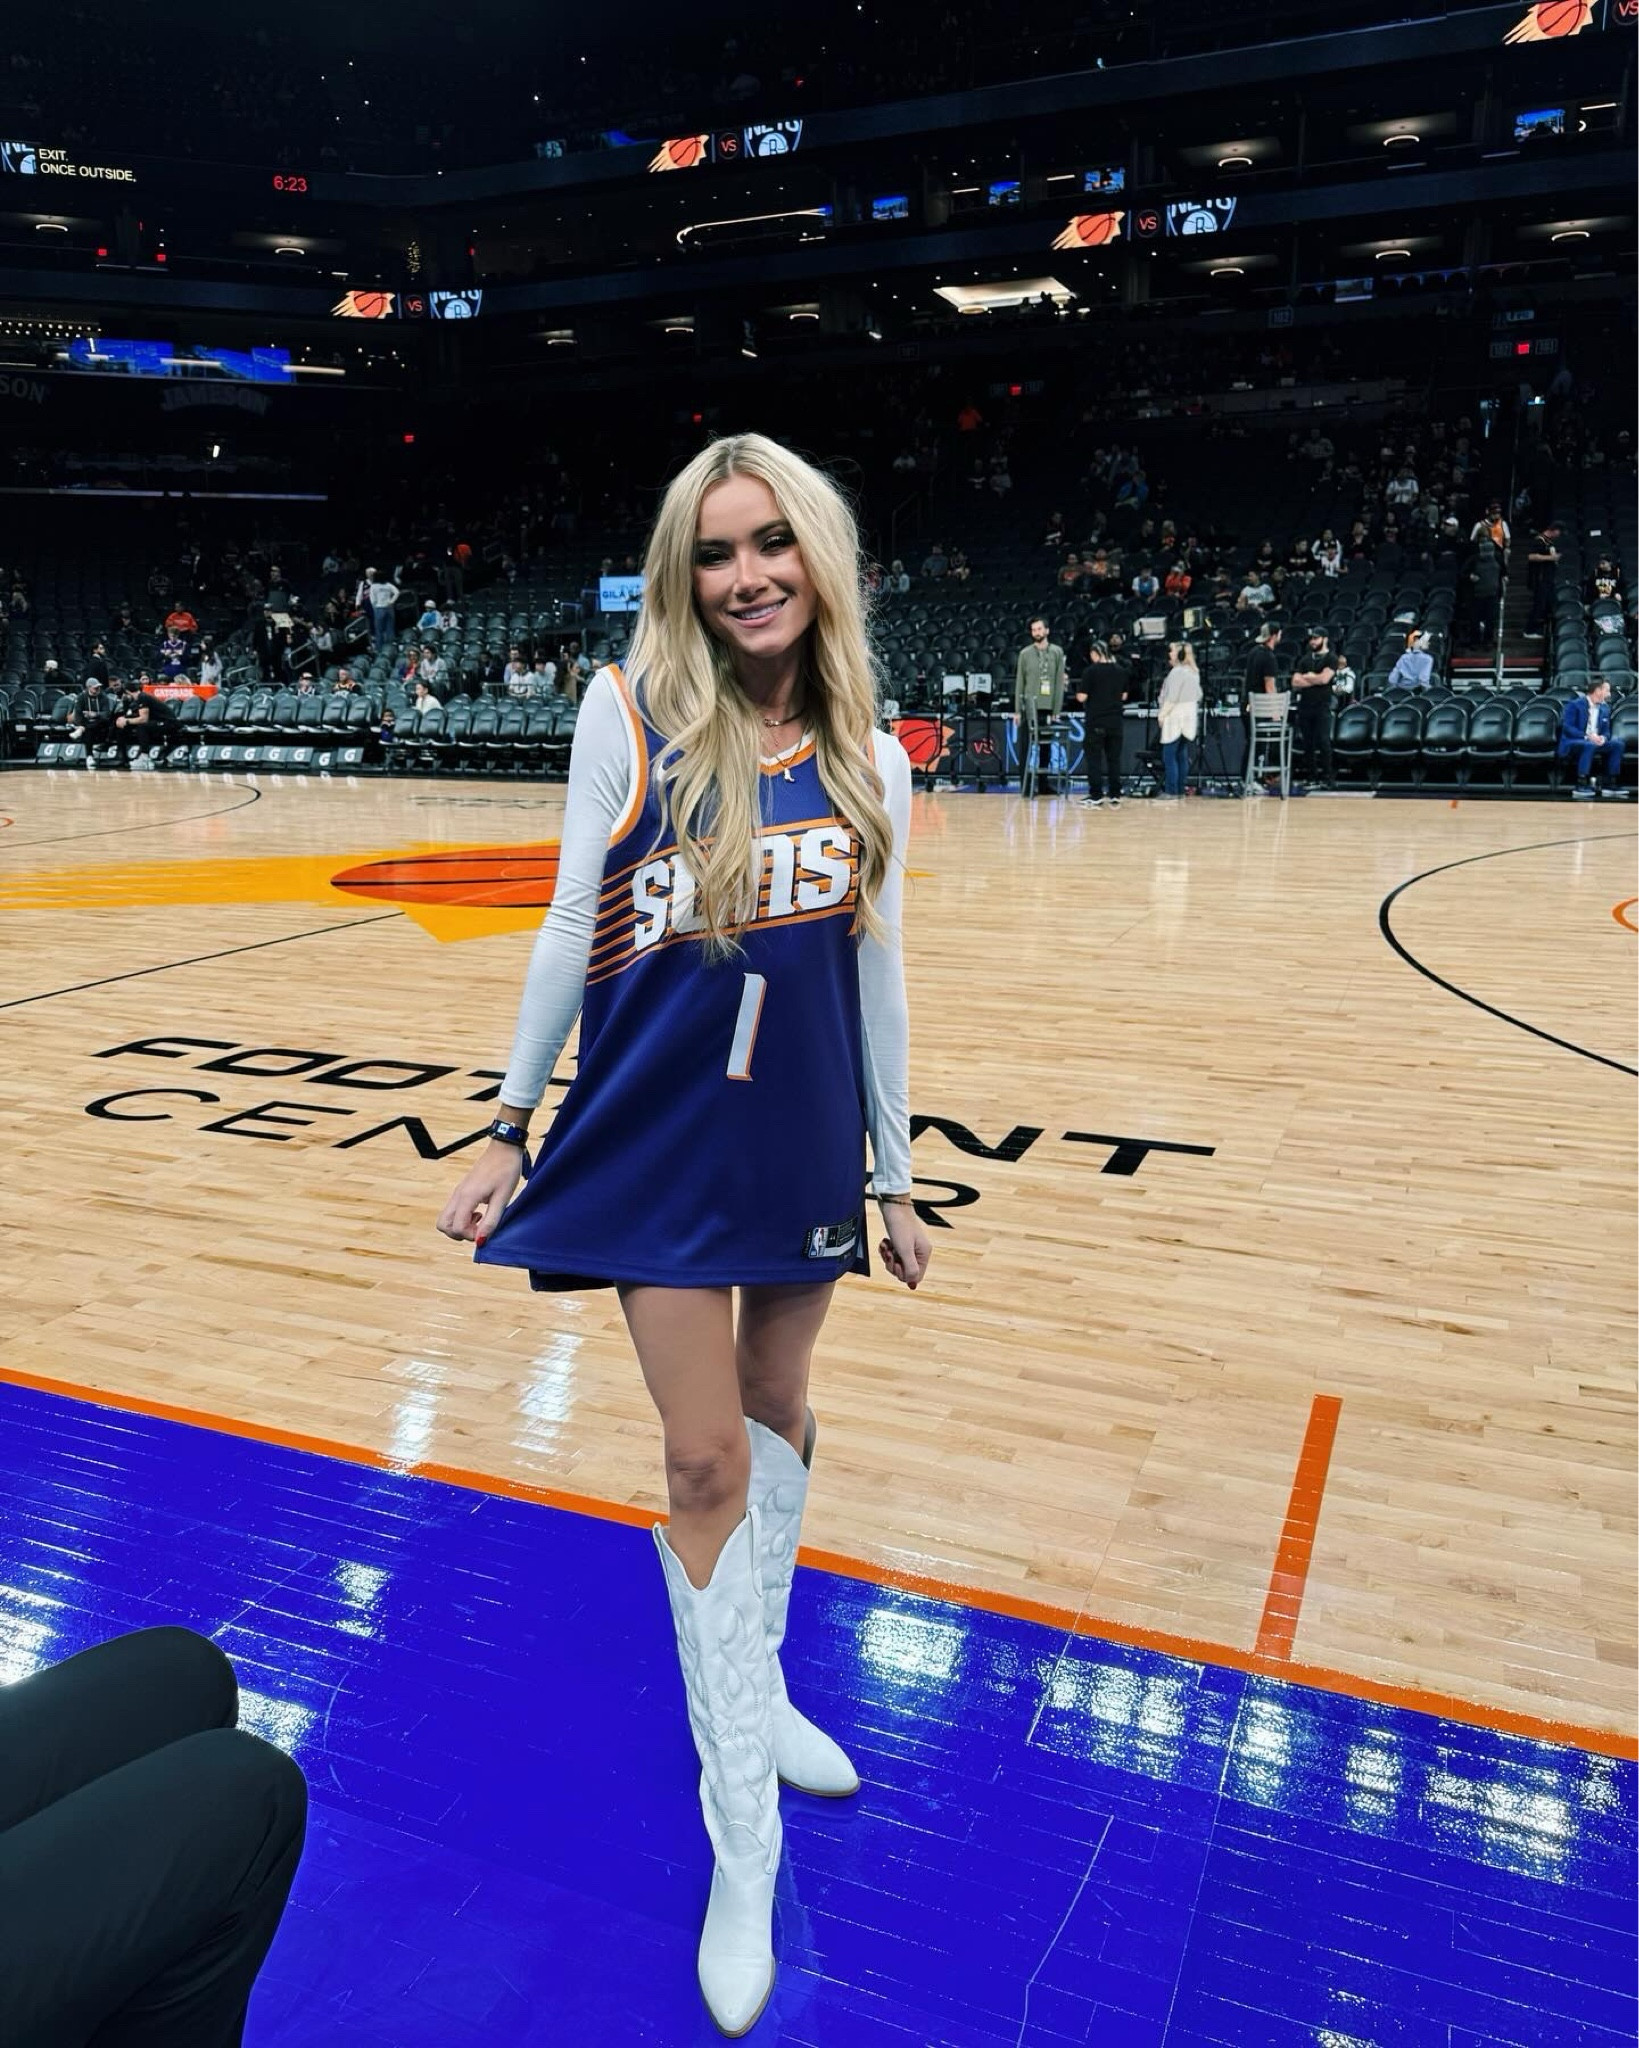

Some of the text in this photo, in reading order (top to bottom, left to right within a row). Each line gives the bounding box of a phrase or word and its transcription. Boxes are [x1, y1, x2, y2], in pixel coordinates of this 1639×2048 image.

[720, 139, 737, 153] VS
[38, 148, 69, 161] EXIT.
[40, 163, 137, 183] ONCE OUTSIDE.
[273, 175, 308, 192] 6:23
[1139, 215, 1157, 230] VS
[407, 300, 423, 312] VS
[631, 826, 852, 952] SUNS
[727, 972, 768, 1082] 1
